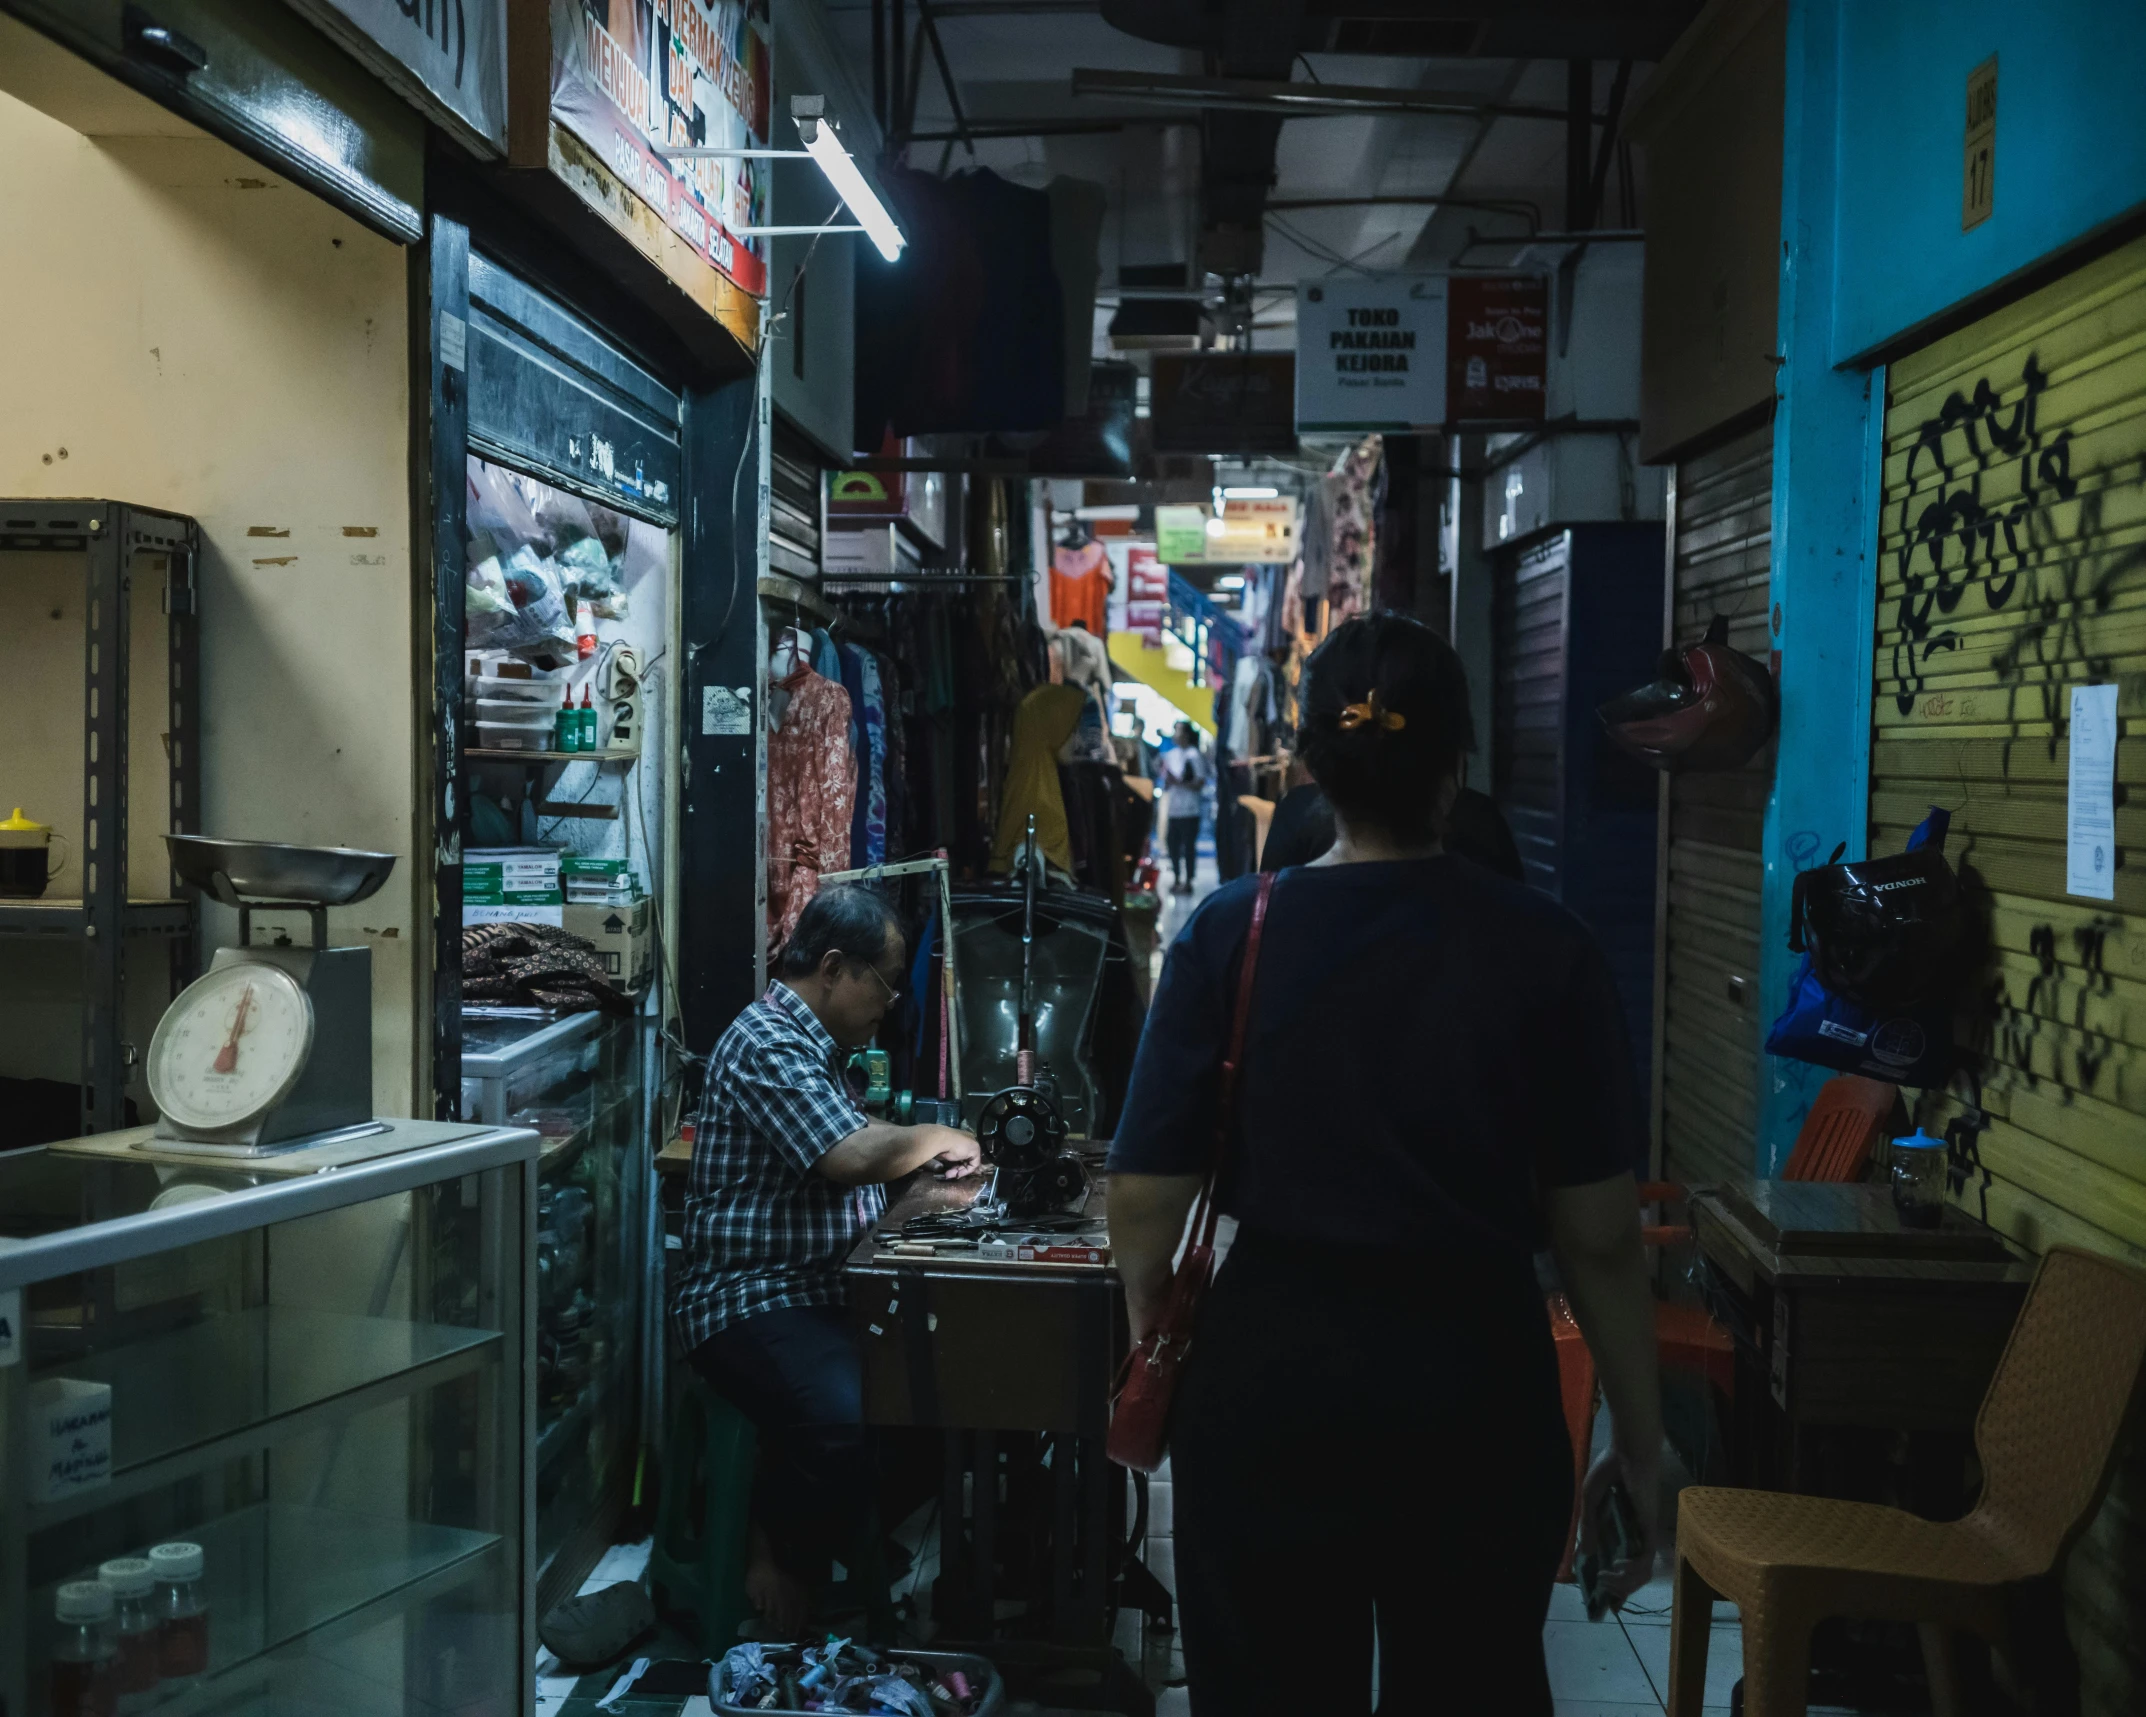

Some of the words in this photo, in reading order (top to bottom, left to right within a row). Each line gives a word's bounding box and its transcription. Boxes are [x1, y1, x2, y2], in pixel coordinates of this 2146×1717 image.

[670, 0, 723, 91] VERMAK
[586, 9, 650, 141] MENJUAL
[668, 42, 694, 121] DAN
[615, 128, 641, 185] PASAR
[645, 159, 668, 215] SANTA
[679, 194, 706, 252] JAKARTA
[708, 223, 734, 275] SELATAN
[1330, 331, 1416, 349] PAKAIAN
[1347, 307, 1400, 327] TOKO
[1336, 354, 1409, 372] KEJORA
[1872, 876, 1928, 892] HONDA
